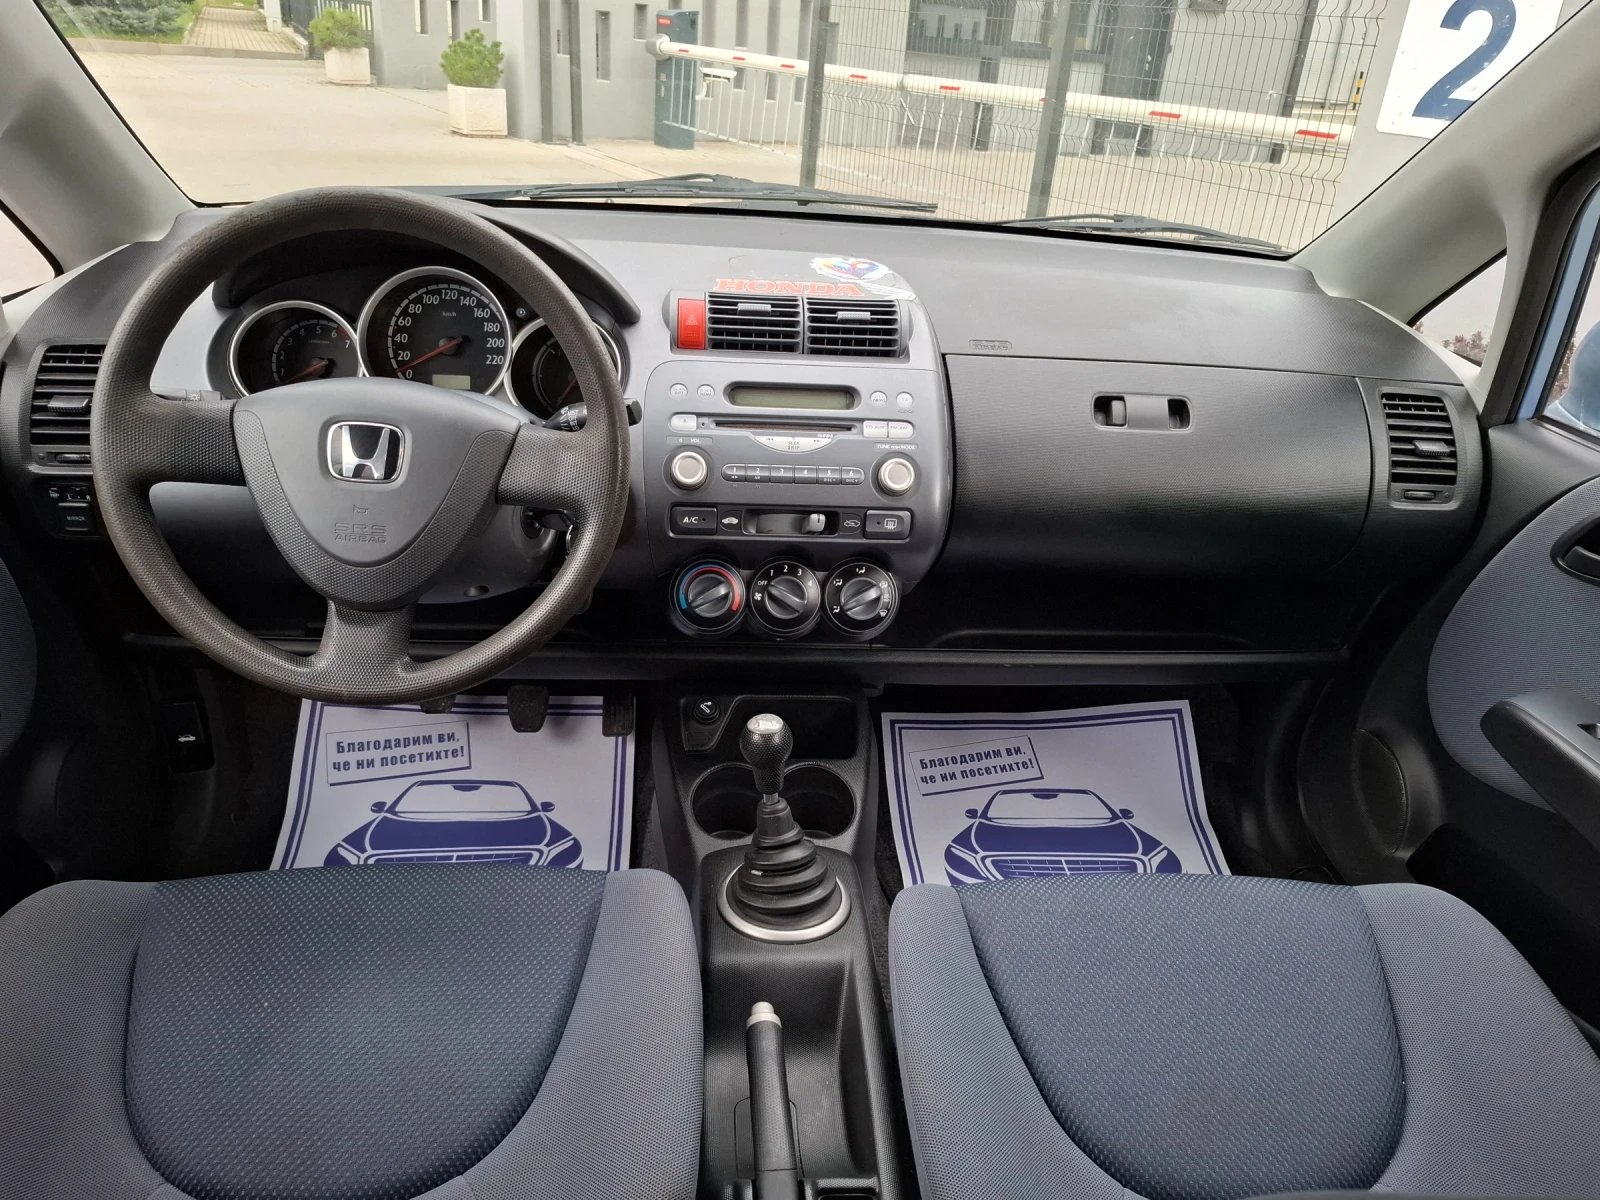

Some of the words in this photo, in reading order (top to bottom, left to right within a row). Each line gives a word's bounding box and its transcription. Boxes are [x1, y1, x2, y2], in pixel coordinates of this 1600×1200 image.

[1411, 0, 1516, 121] 2
[714, 278, 865, 296] HONDA
[442, 290, 457, 299] 120
[423, 295, 439, 304] 100
[460, 296, 476, 306] 140
[408, 304, 422, 313] 80
[474, 308, 490, 318] 160
[398, 317, 411, 326] 60
[484, 322, 500, 332] 180
[299, 328, 304, 336] 4
[331, 330, 337, 338] 6
[394, 334, 408, 342] 40
[486, 338, 504, 347] 200
[345, 340, 350, 348] 7
[280, 351, 285, 359] 2
[398, 351, 410, 360] 20
[486, 355, 504, 364] 220
[281, 368, 284, 376] 1
[406, 370, 412, 378] 0
[683, 516, 699, 524] A/C
[334, 522, 387, 536] SRS
[334, 534, 387, 544] AIRBAG
[336, 734, 432, 754] Благодарим
[437, 732, 460, 744] ви,
[332, 760, 350, 772] че
[356, 758, 375, 769] ни
[380, 746, 465, 767] посетихте!
[919, 748, 1002, 770] Благодарим
[1005, 746, 1026, 757] ви,
[920, 774, 937, 785] че
[940, 771, 957, 782] ни
[960, 758, 1034, 779] посетихте!
